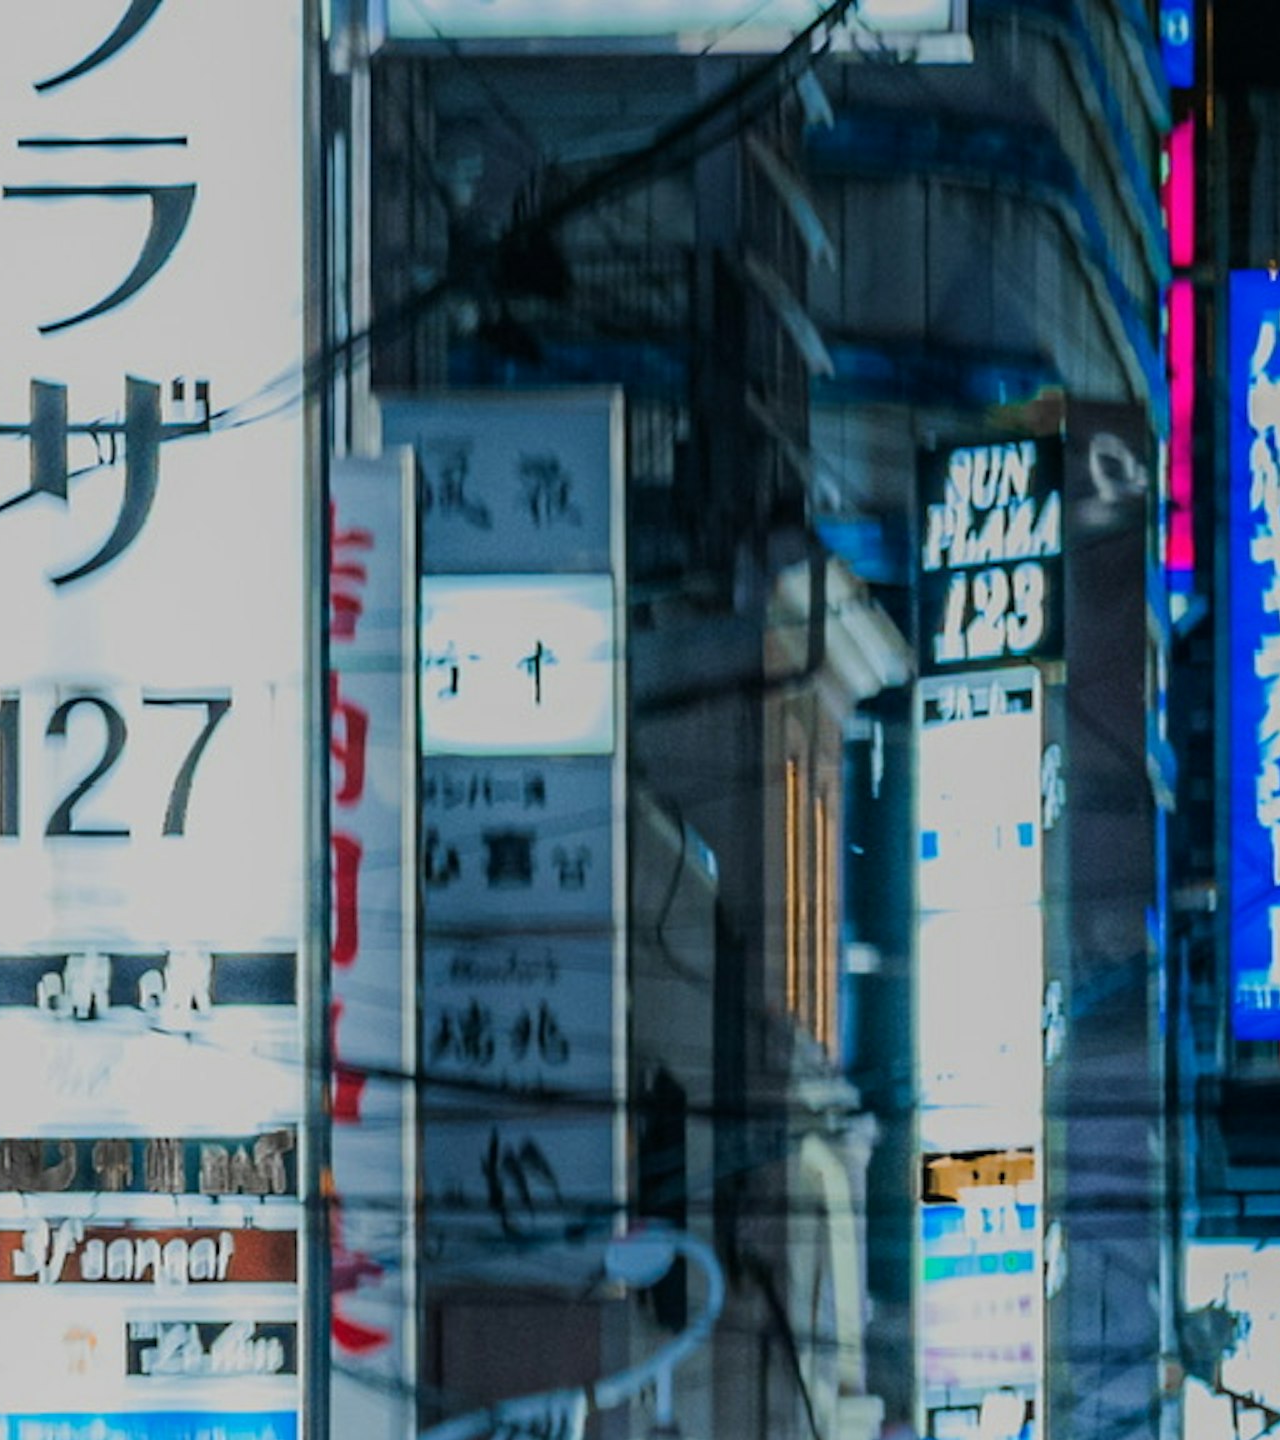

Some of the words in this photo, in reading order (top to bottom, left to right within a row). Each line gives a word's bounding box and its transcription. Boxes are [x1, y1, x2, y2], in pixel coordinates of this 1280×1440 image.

[945, 440, 1037, 510] SUN
[923, 490, 1062, 572] PLAZA
[934, 562, 1045, 664] 123
